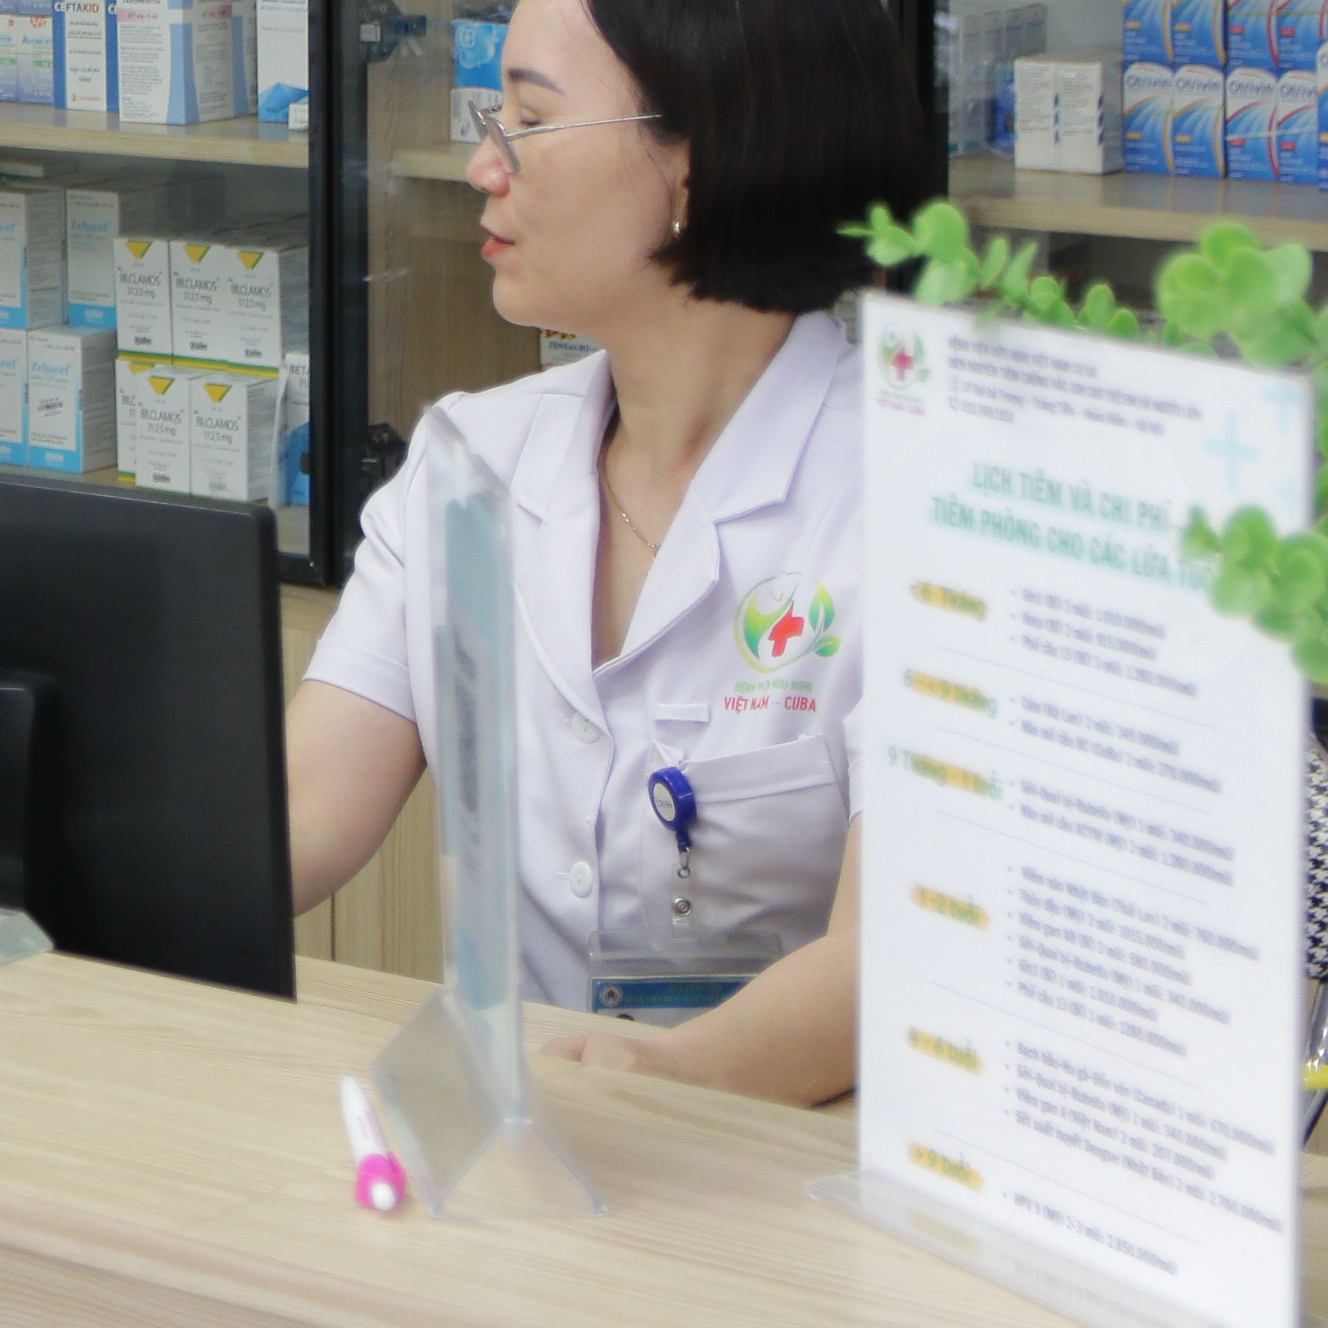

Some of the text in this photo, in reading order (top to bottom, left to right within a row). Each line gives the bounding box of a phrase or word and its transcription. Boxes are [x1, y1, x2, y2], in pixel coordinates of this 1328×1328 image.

[53, 1, 100, 14] CEFTAKID
[749, 695, 770, 712] NAM
[784, 696, 817, 712] CUBA
